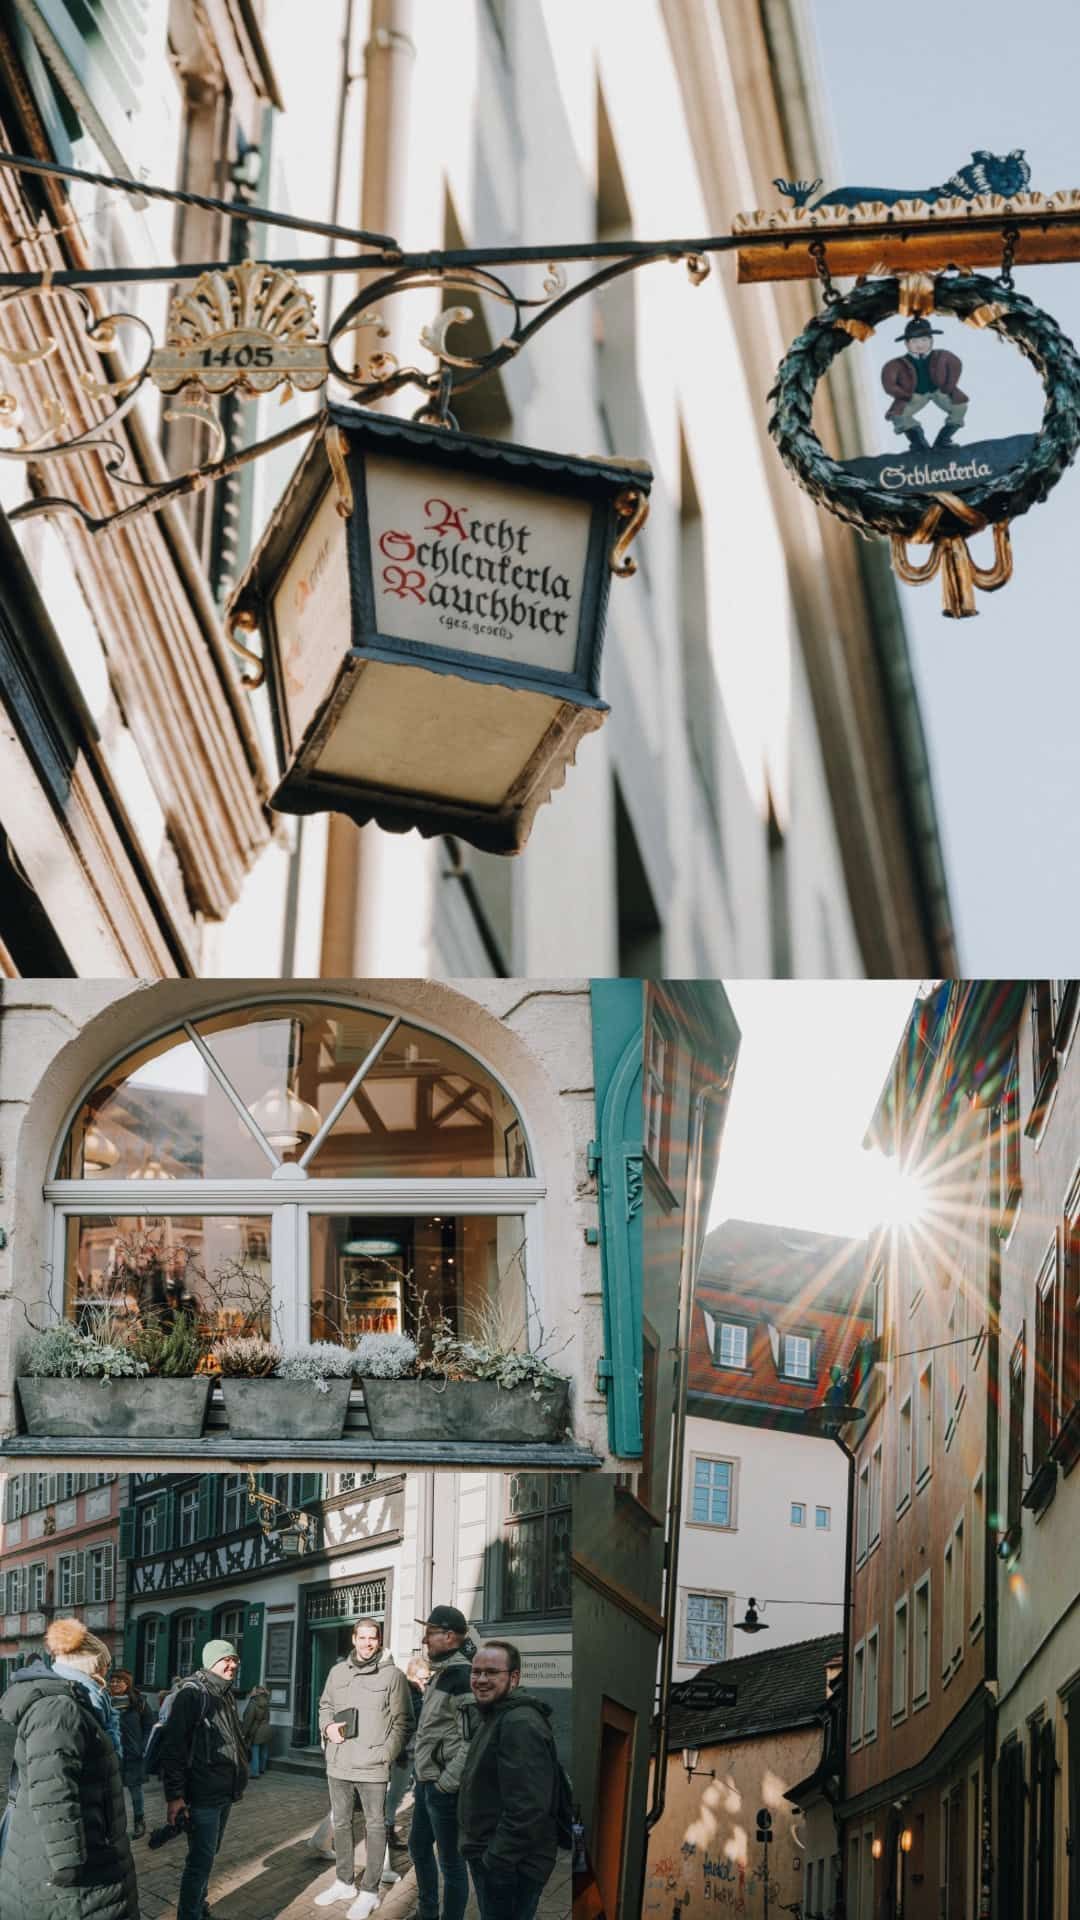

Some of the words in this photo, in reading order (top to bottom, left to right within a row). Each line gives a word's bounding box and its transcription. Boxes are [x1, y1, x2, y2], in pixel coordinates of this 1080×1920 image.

[200, 344, 274, 368] 1405
[879, 459, 993, 490] Schlenkerla
[424, 498, 531, 556] Aecht
[379, 529, 572, 601] Schlenkerla
[382, 565, 570, 637] Rauchbier
